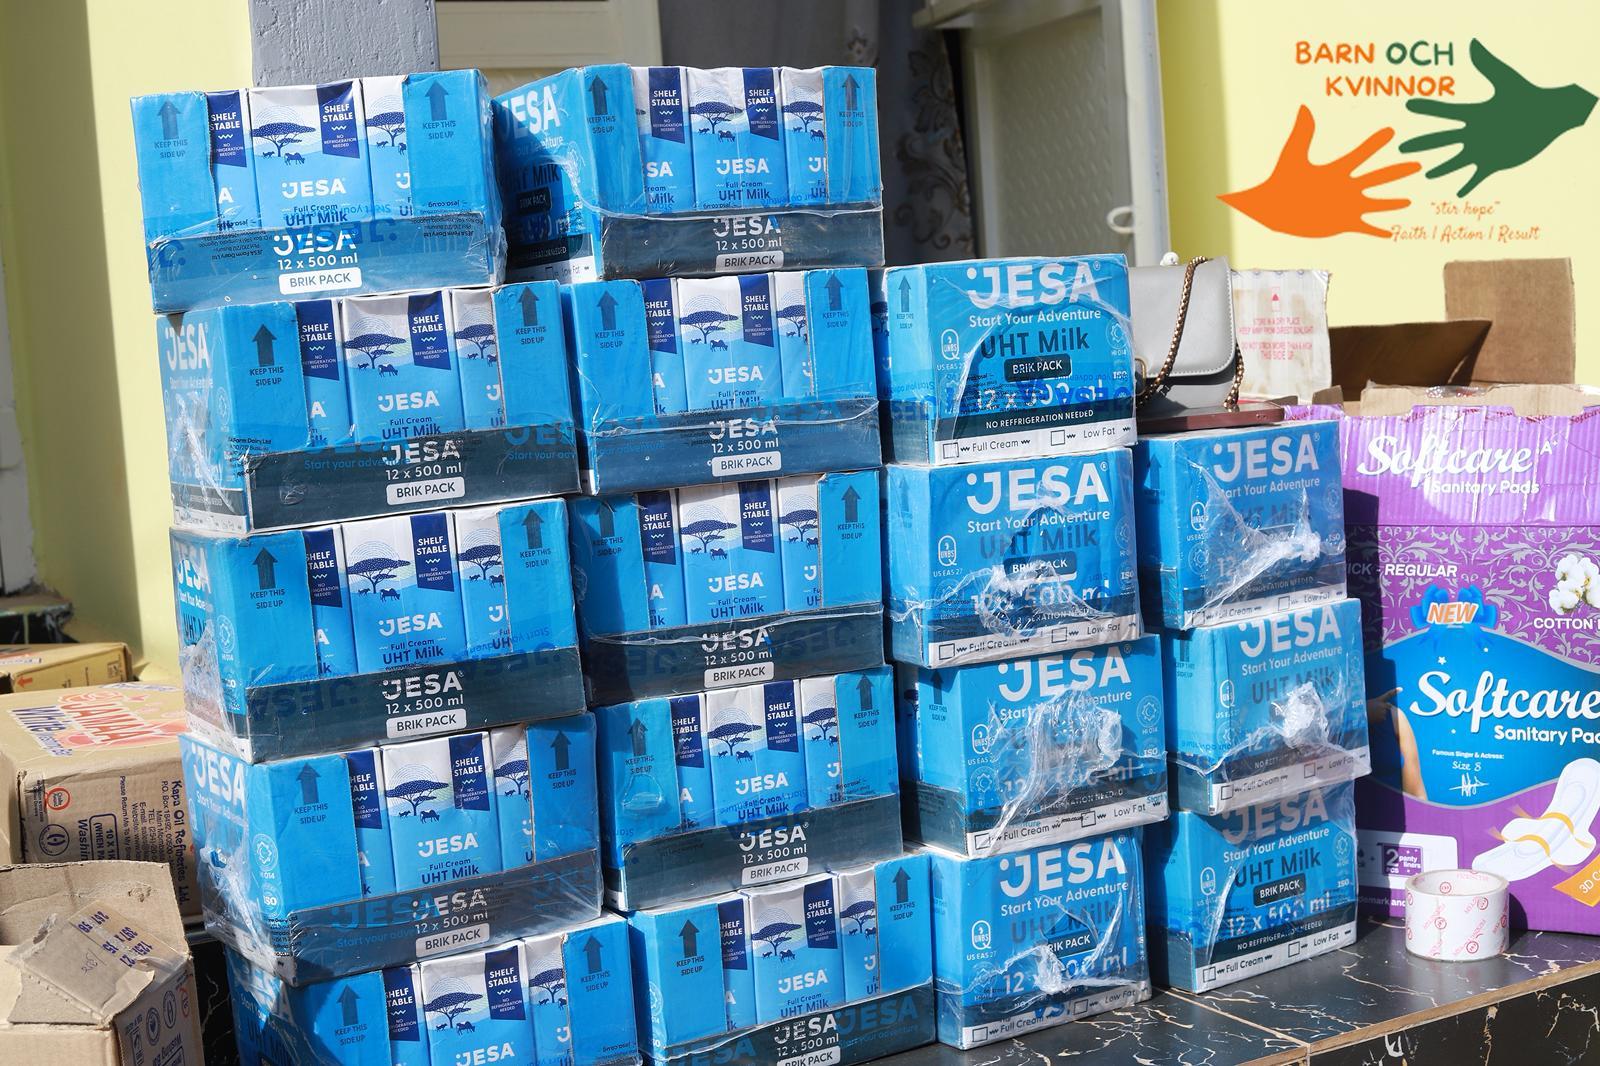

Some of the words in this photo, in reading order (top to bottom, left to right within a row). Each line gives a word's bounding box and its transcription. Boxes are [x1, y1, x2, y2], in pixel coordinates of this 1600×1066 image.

[715, 158, 770, 175] JESA
[281, 179, 346, 198] JESA
[724, 257, 746, 268] BRIK
[748, 254, 775, 266] PACK
[289, 276, 316, 288] BRIK
[318, 273, 351, 285] PACK
[966, 262, 1101, 309] JESA
[412, 322, 444, 333] STABLE
[413, 314, 440, 325] SHELF
[970, 316, 1002, 328] Start
[1004, 313, 1034, 325] Your
[1037, 309, 1101, 323] Adventure
[981, 333, 1029, 359] UHT
[1039, 327, 1089, 352] Milk
[249, 367, 267, 376] KEEP
[268, 366, 284, 374] THIS
[708, 365, 764, 384] JESA
[1012, 363, 1035, 375] BRIK
[1037, 360, 1062, 372] PACK
[255, 378, 269, 387] SIDE
[270, 377, 282, 385] UP
[378, 392, 440, 412] JESA
[406, 415, 432, 424] Cream
[986, 421, 998, 429] NO
[1065, 410, 1093, 419] NEEDED
[1083, 429, 1100, 439] Low
[1102, 428, 1115, 436] Fat
[973, 442, 989, 452] Full
[991, 439, 1019, 450] Cream
[1213, 433, 1319, 482] JESA
[1356, 435, 1533, 489] Softcare
[386, 469, 401, 481] 12
[415, 465, 442, 478] 500
[446, 462, 462, 474] ml
[397, 486, 421, 499] BRIK
[424, 482, 455, 496] PACK
[966, 462, 1109, 514] JESA
[1244, 484, 1266, 496] Your
[1270, 478, 1320, 492] Adventure
[1432, 481, 1497, 497] Sanitary
[1501, 481, 1539, 494] Pads
[743, 509, 770, 519] STABLE
[744, 501, 767, 511] SHELF
[416, 544, 447, 555] STABLE
[418, 536, 444, 547] SHELF
[1347, 563, 1373, 576] ICK
[1384, 563, 1457, 577] REGULAR
[708, 572, 764, 593] JESA
[1427, 602, 1479, 625] NEW
[379, 612, 443, 637] JESA
[1239, 606, 1341, 658] JESA
[1533, 618, 1594, 630] COTTON
[382, 650, 411, 665] UHT
[415, 647, 444, 661] Milk
[1242, 663, 1267, 676] Start
[1269, 658, 1290, 671] Your
[1294, 646, 1342, 664] Adventure
[998, 646, 1131, 701] JESA
[382, 672, 463, 701] JESA
[386, 702, 401, 715] 12
[404, 704, 411, 712] x
[415, 698, 443, 712] 500
[447, 694, 464, 706] ml
[769, 702, 791, 712] SHELF
[1409, 670, 1600, 733] Softcare
[61, 702, 154, 743] JAMAA
[396, 718, 423, 732] BRIK
[425, 714, 457, 727] PACK
[767, 710, 794, 720] STABLE
[1494, 724, 1568, 746] Sanitary
[455, 756, 480, 768] SHELF
[1432, 749, 1454, 757] Famous
[453, 765, 483, 777] STABLE
[1452, 760, 1472, 772] Size
[1474, 761, 1482, 772] 8
[736, 772, 789, 795] JESA
[162, 795, 170, 808] Box
[171, 780, 182, 806] Kapa
[121, 796, 129, 816] Return
[122, 817, 129, 827] Me
[174, 810, 185, 826] Oil
[1221, 790, 1328, 844] JESA
[78, 819, 90, 860] Washin
[93, 822, 104, 849] (WHEN
[106, 829, 115, 839] 10
[122, 836, 130, 846] My
[124, 828, 130, 836] To
[107, 849, 116, 860] 1K
[418, 833, 479, 858] JESA
[1224, 850, 1249, 863] Start
[1253, 842, 1275, 856] Your
[1278, 828, 1330, 849] Adventure
[97, 850, 105, 860] PA
[173, 830, 187, 882] Refineries
[1386, 849, 1398, 868] 2
[1399, 856, 1418, 864] panty
[421, 870, 448, 886] UHT
[450, 865, 480, 880] Milk
[750, 866, 772, 880] BRIK
[774, 862, 800, 874] PACK
[999, 836, 1127, 898] JESA
[1259, 886, 1277, 899] BRIK
[1279, 880, 1300, 894] PACK
[1579, 877, 1594, 894] 3D
[808, 899, 830, 910] SHELF
[1001, 901, 1032, 917] Start
[1035, 894, 1062, 909] Your
[1066, 882, 1129, 903] Adventure
[806, 907, 833, 919] STABLE
[1313, 937, 1326, 946] Low
[1327, 932, 1339, 943] Fat
[489, 967, 514, 979] SHELF
[1226, 962, 1238, 974] Full
[1240, 956, 1263, 969] Cream
[488, 975, 518, 987] STABLE
[778, 969, 828, 994] JESA
[455, 1042, 514, 1066] JESA
